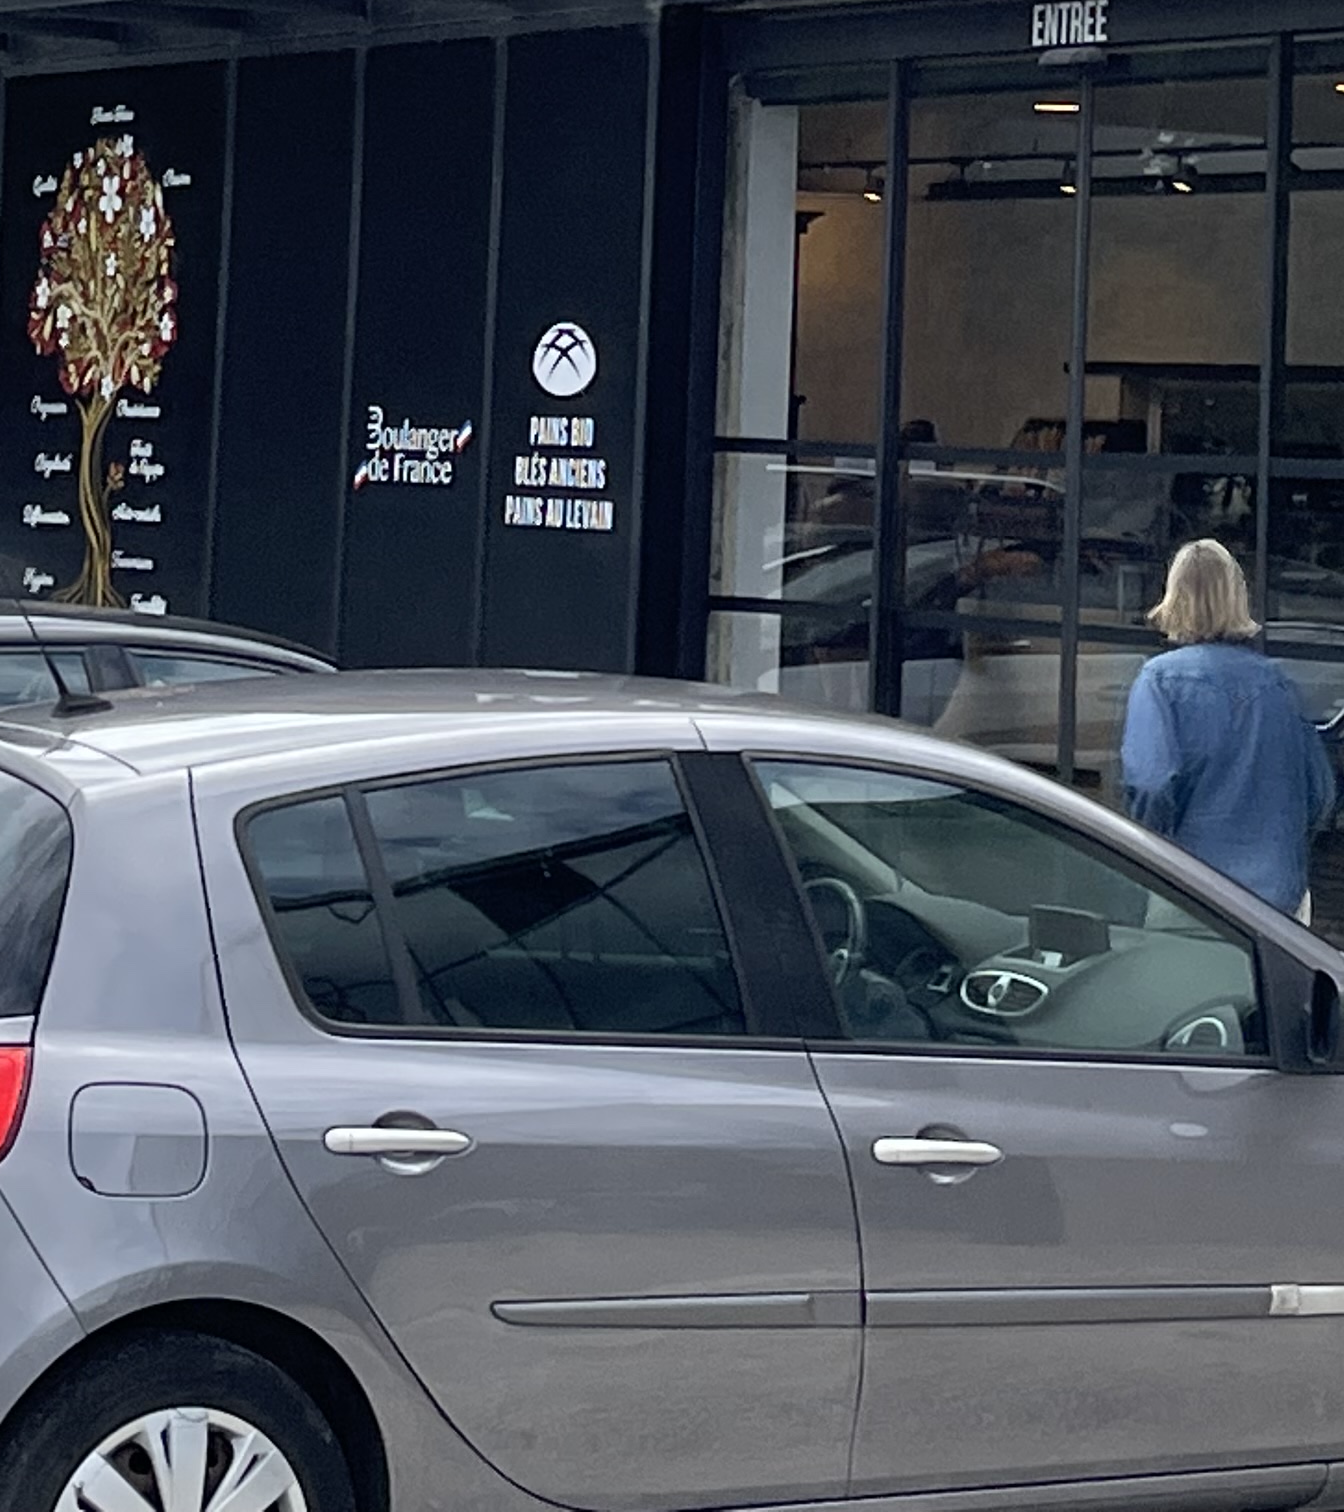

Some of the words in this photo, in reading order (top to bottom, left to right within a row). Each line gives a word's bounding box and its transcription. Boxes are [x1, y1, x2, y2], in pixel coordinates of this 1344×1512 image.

[1032, 0, 1109, 46] ENTREE
[366, 405, 459, 460] Boulanger
[529, 416, 568, 446] PAINS
[571, 417, 594, 447] BIO
[367, 449, 389, 481] de
[393, 453, 453, 484] France
[515, 451, 547, 487] BLÉS
[548, 457, 606, 489] ANCIENS
[504, 495, 544, 526] PAINS
[545, 498, 564, 527] AU
[565, 498, 613, 530] LEVAIN
